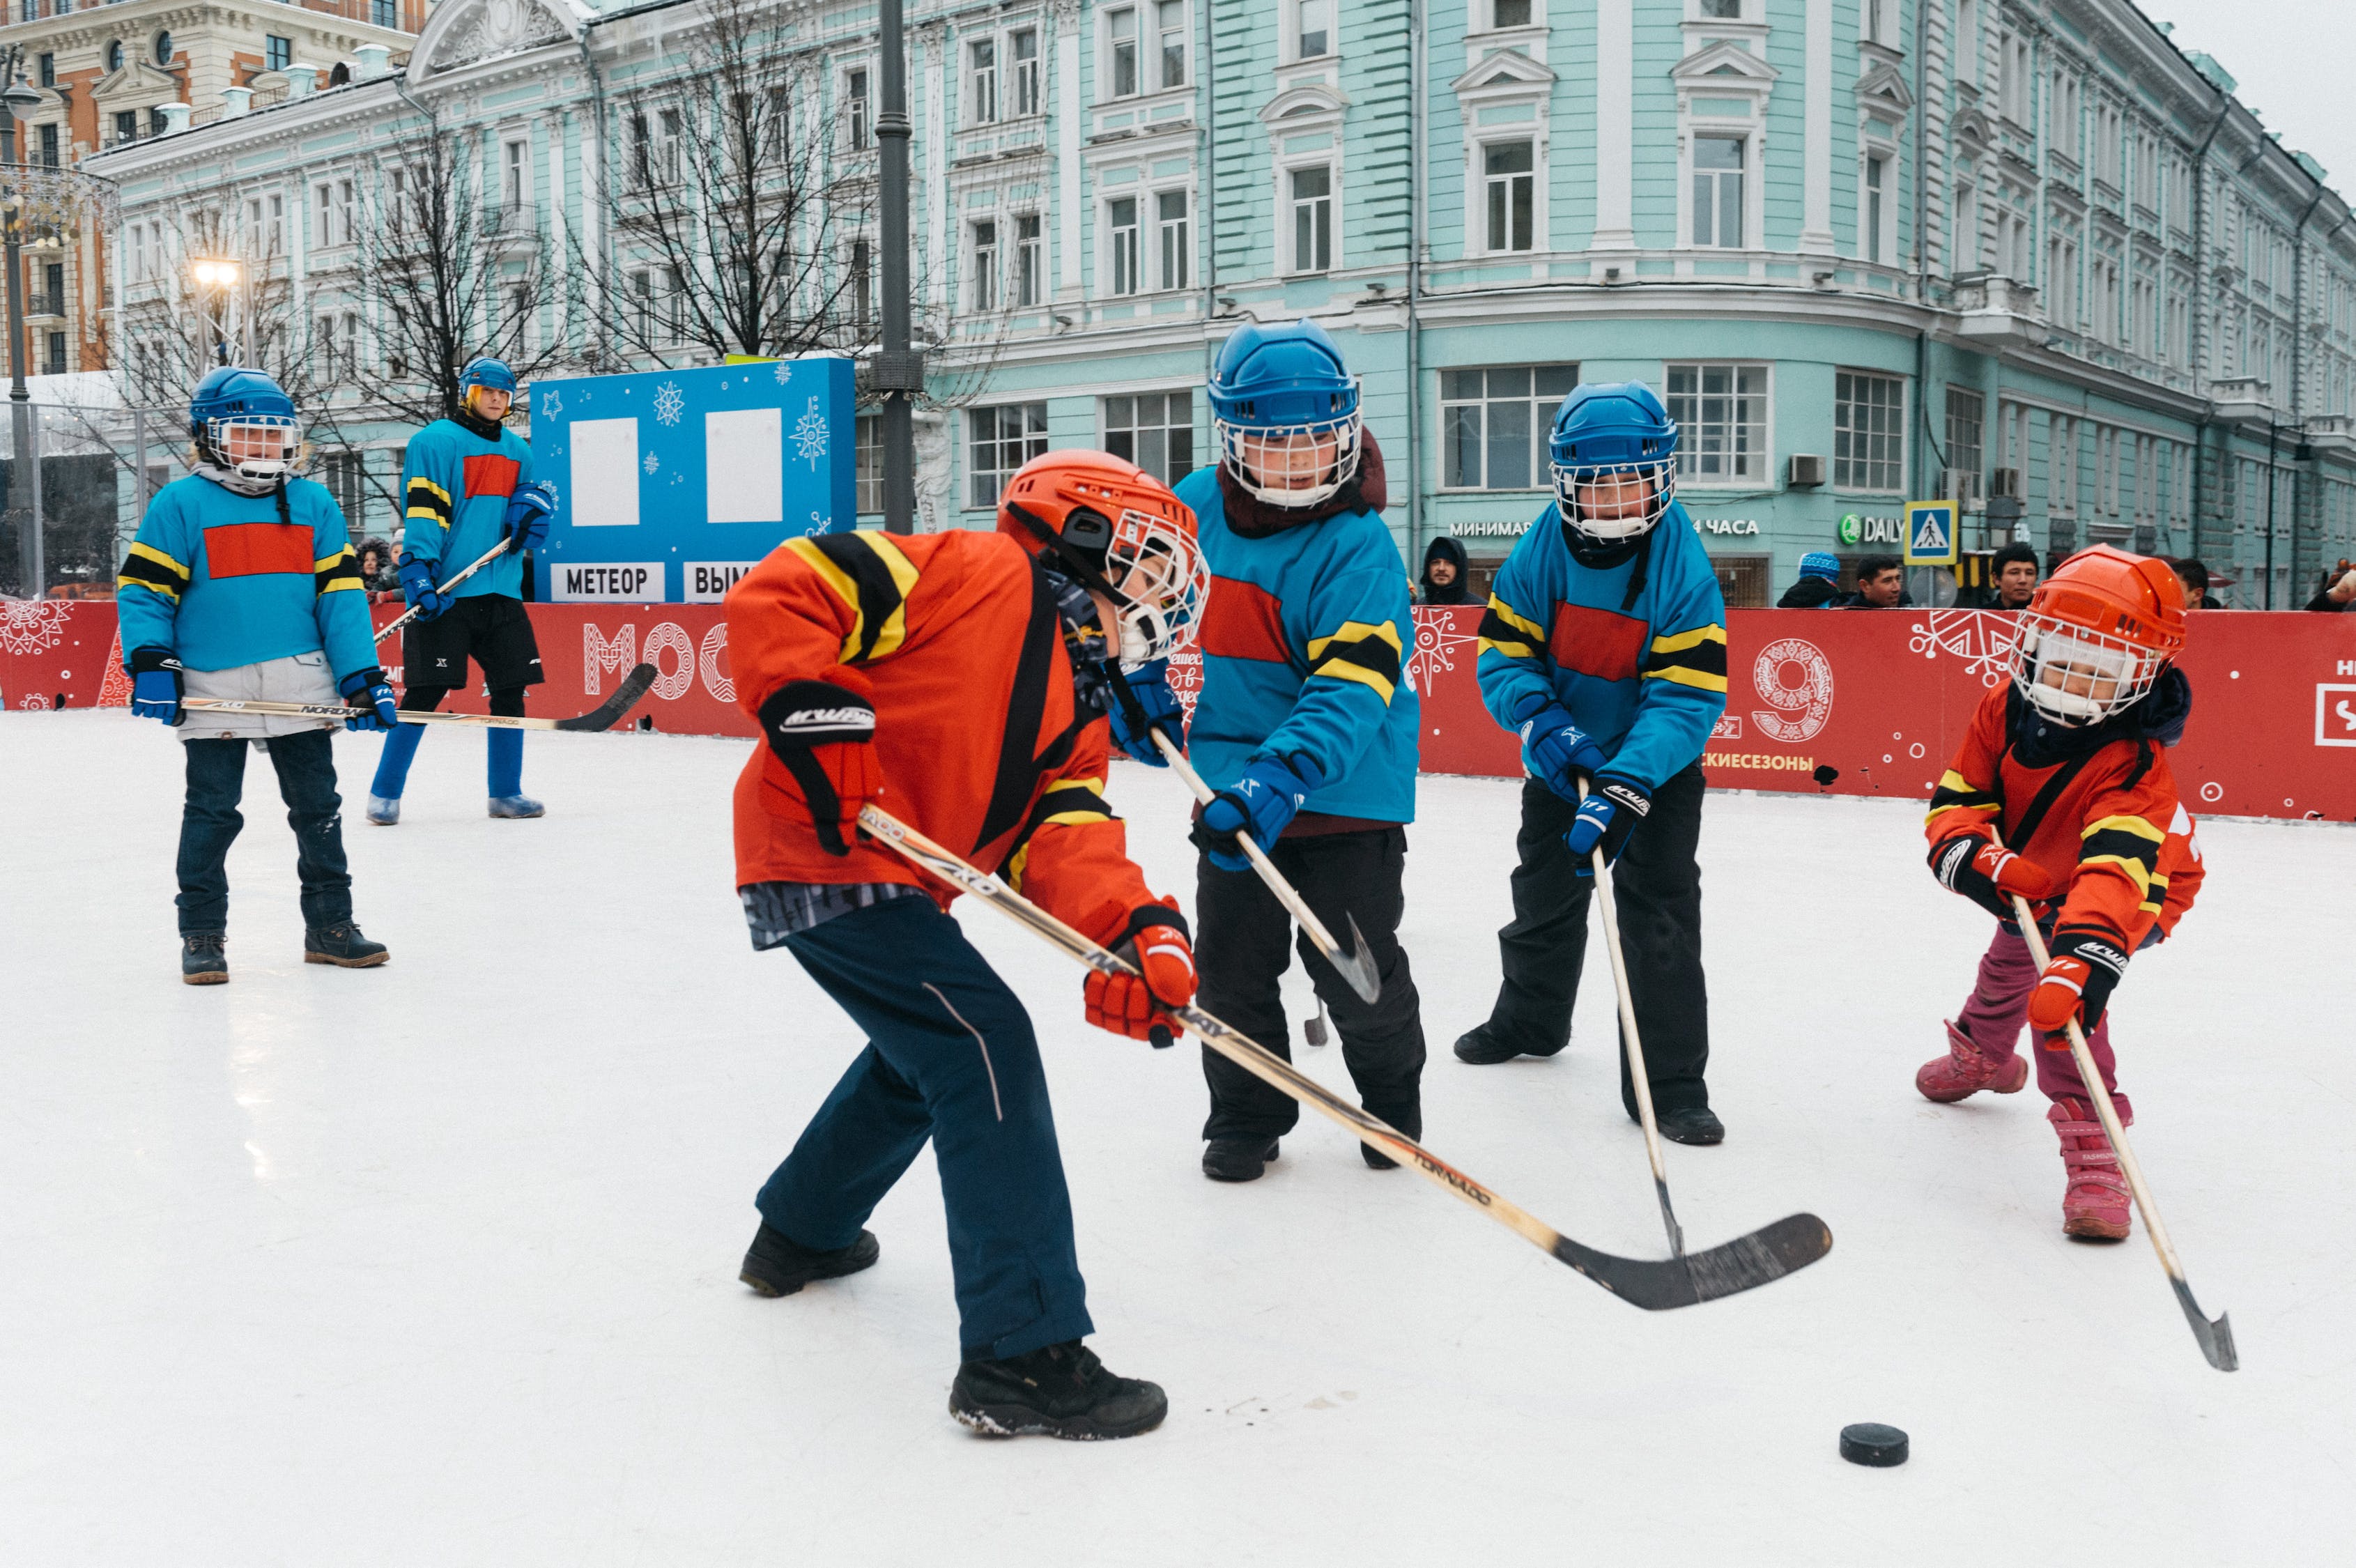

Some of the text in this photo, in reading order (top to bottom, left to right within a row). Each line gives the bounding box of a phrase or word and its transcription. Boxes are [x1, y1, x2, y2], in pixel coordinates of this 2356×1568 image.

[1706, 519, 1760, 535] ЧАСА
[1863, 516, 1905, 542] DAILY
[567, 568, 647, 594] МЕТЕОР
[1414, 1151, 1492, 1206] TORNADO
